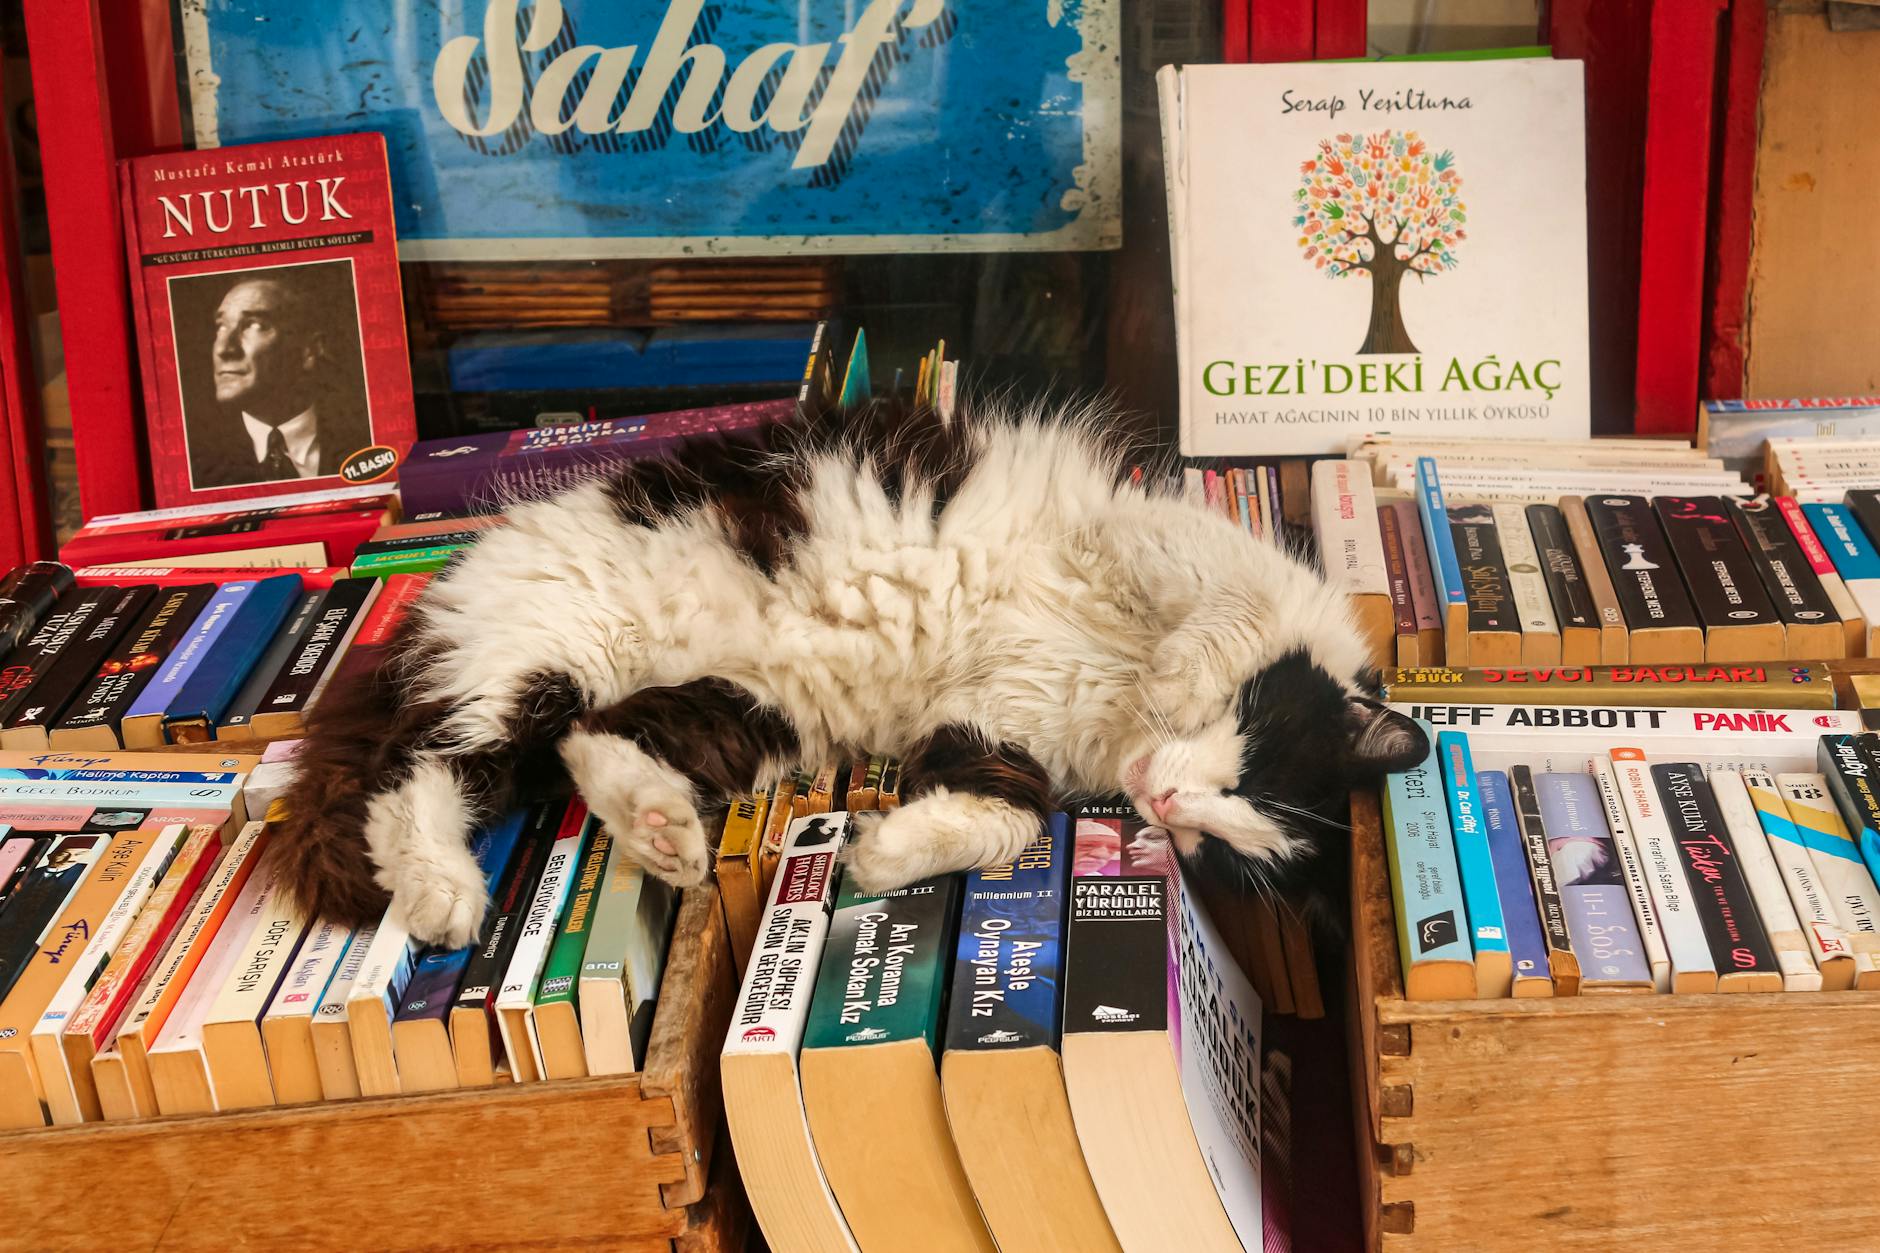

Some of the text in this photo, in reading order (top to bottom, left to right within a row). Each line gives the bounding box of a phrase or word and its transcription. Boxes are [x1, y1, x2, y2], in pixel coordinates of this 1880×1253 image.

[433, 0, 946, 180] Sahaf
[1282, 89, 1472, 118] Serap Yeşiltuna
[154, 150, 344, 182] Mustafa Kemal Atatürk
[157, 177, 352, 238] NUTUK
[1440, 354, 1562, 400] AĞAÇ
[1215, 403, 1550, 425] HAYAT AĞACININ 10 BİN YILLIK ÖYKÜSÜ
[527, 421, 612, 438] TÜRKİYE
[359, 451, 395, 473] BASKI
[1724, 586, 1743, 604] MEYER
[1784, 586, 1803, 605] MEYER
[321, 607, 348, 622] ELİF
[1646, 599, 1664, 619] MEYER
[27, 612, 71, 647] TUZAK
[40, 602, 98, 656] KUSURSUZ
[86, 616, 119, 642] MELEK
[87, 674, 119, 705] LYNDS
[103, 672, 135, 703] GAYLE
[1397, 673, 1465, 683] S. BUCK
[1506, 707, 1668, 729] ABBOTT
[1693, 710, 1793, 733] PANİK
[1836, 743, 1868, 777] Ağrılar
[75, 769, 180, 781] Halime Kaptan
[1405, 768, 1431, 800] fteri
[66, 786, 141, 796] BODRUM
[1599, 773, 1613, 796] YILMAZ
[1606, 795, 1621, 824] ERDOĞAN
[1626, 768, 1652, 818] ROBIN SHARMA
[1668, 772, 1707, 833] AYŞE KULİN
[148, 815, 197, 824] ARION
[1081, 806, 1132, 815] AHMET
[1460, 801, 1475, 814] Can
[112, 839, 143, 860] Ayşe
[98, 861, 129, 882] Kulin
[786, 856, 812, 902] HOLMES
[805, 854, 827, 899] SHERLOCK
[1660, 873, 1674, 893] Satan
[523, 854, 566, 937] BEN BÜYÜYÜNCE
[910, 886, 935, 896] III
[973, 889, 1053, 900] millennium II
[1075, 884, 1162, 897] PARALEL
[1075, 896, 1160, 909] YÜRÜDÜK
[1665, 893, 1680, 912] Bilge
[1075, 908, 1162, 917] BİZ BU YOLLARDA
[43, 918, 89, 964] Füreya
[265, 920, 290, 947] DÖRT
[146, 988, 159, 1006] Dost
[157, 956, 183, 989] Kazanma
[199, 891, 223, 919] Etkileme
[970, 919, 1012, 986] Oynayan
[236, 950, 275, 993] SARIŞIN
[585, 961, 620, 971] and
[740, 908, 792, 1025] SUÇUN GERÇEĞİDİR
[768, 918, 812, 1012] AKLIN ŞÜPHESİ
[839, 912, 889, 1025] Çomak Sokan Kız
[877, 945, 915, 1007] Kovanına
[1005, 941, 1043, 991] Ateşle
[971, 990, 1005, 1018] Kız
[845, 1031, 888, 1042] PEGASUS
[978, 1035, 1020, 1044] PEGASUS
